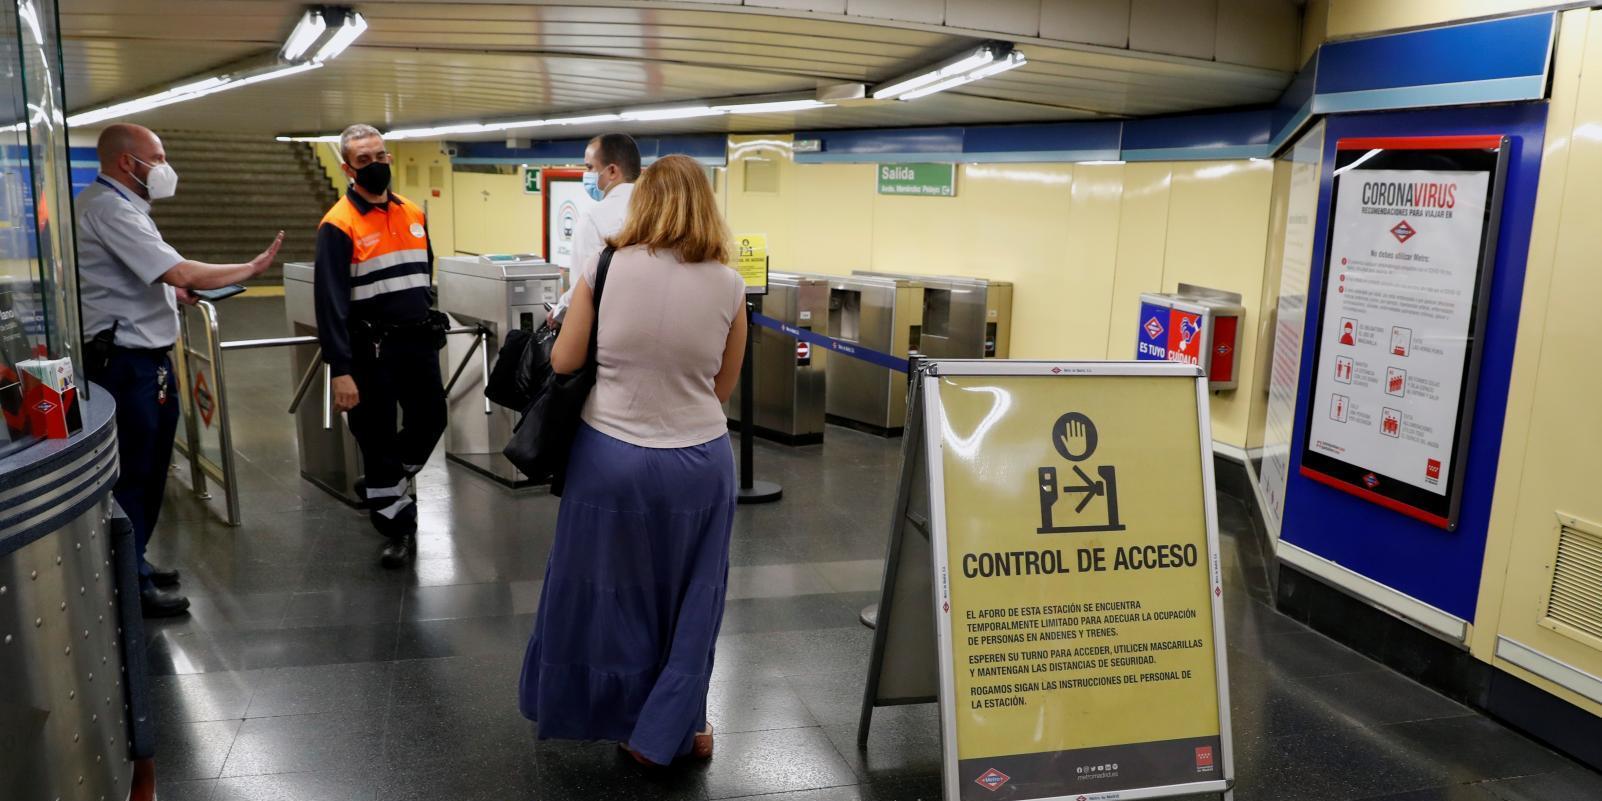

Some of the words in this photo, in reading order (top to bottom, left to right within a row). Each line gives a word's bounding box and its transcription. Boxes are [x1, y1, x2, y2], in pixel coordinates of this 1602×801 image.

[882, 167, 915, 180] Salida
[1362, 182, 1457, 209] CORONAVIRUS
[1362, 207, 1408, 217] RECOMENDACIONES
[1410, 209, 1423, 217] PARA
[1425, 210, 1444, 218] VIAJAR
[1445, 211, 1453, 219] EN
[1140, 342, 1148, 352] ES
[1149, 344, 1165, 358] TUYO
[962, 550, 1069, 578] CONTROL
[1077, 548, 1106, 572] DE
[1114, 544, 1197, 570] ACCESO
[967, 611, 976, 619] EL
[979, 609, 1006, 618] AFORO
[1009, 608, 1019, 616] DE
[1021, 607, 1040, 616] ESTA
[1043, 603, 1081, 614] ESTACIÓN
[1084, 604, 1093, 612] SE
[1096, 601, 1141, 611] ENCUENTRA
[967, 620, 1039, 632] TEMPORALMENTE
[1041, 617, 1078, 628] LIMITADO
[1081, 616, 1101, 625] PARA
[1104, 613, 1140, 624] ADECUAR
[1142, 612, 1152, 621] LA
[1154, 608, 1196, 620] OCUPACIÓN
[968, 637, 979, 646] DE
[982, 634, 1024, 644] PERSONAS
[1027, 633, 1037, 641] EN
[1040, 630, 1077, 641] ANDENES
[1079, 630, 1084, 638] Y
[1086, 628, 1118, 637] TRENES.
[969, 653, 1006, 664] ESPEREN
[1008, 652, 1019, 661] SU
[1021, 650, 1048, 660] TURNO
[1051, 649, 1072, 657] PARA
[1074, 646, 1112, 656] ACCEDER,
[1114, 643, 1148, 654] UTILICEN
[1150, 639, 1202, 651] MASCARILLAS
[970, 669, 974, 678] Y
[978, 666, 1029, 677] MANTENGAN
[1032, 664, 1046, 673] LAS
[1050, 660, 1096, 671] DISTANCIAS
[1099, 659, 1108, 667] DE
[1111, 656, 1156, 667] SEGURIDAD.
[971, 685, 1012, 696] ROGAMOS
[1014, 683, 1039, 692] SIGAN
[1042, 681, 1057, 690] LAS
[1060, 676, 1121, 688] INSTRUCCIONES
[1124, 675, 1138, 684] DEL
[1140, 672, 1179, 682] PERSONAL
[1182, 670, 1191, 679] DE
[971, 700, 982, 709] LA
[985, 696, 1026, 708] ESTACIÓN.
[985, 775, 1001, 783] Metro
